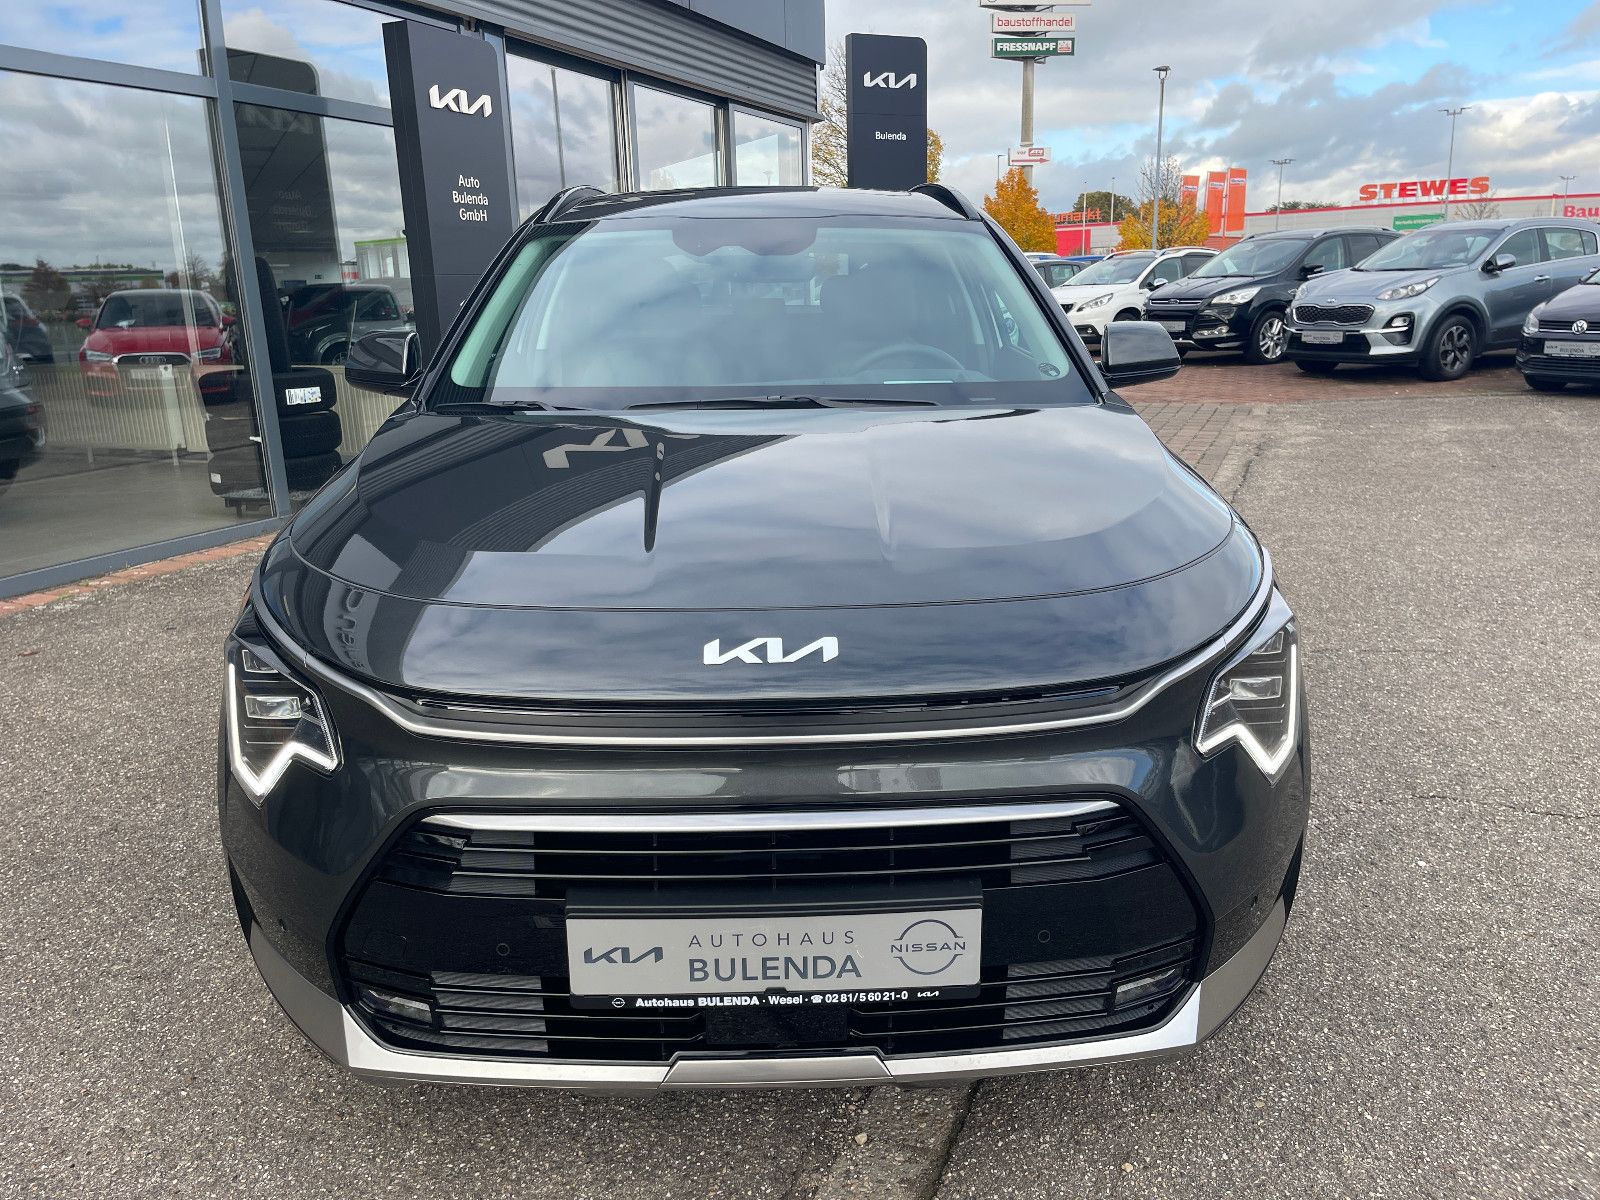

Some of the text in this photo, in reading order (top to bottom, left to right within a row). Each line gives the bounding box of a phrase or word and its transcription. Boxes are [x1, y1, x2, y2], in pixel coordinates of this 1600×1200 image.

[997, 17, 1073, 27] baustoffhandel
[996, 42, 1057, 52] FRESSNAPF
[863, 71, 917, 89] KIA
[429, 84, 493, 118] KIA
[875, 131, 907, 141] Bulenda
[458, 174, 480, 189] Auto
[1359, 176, 1490, 202] STEWES
[452, 190, 489, 206] Bulenda
[459, 208, 488, 222] GmbH
[703, 636, 839, 665] KIA
[688, 930, 855, 949] AUTOHAUS
[890, 940, 966, 954] NISSAN
[583, 946, 664, 964] KIA
[688, 954, 863, 982] BULENDA
[635, 997, 695, 1008] Autohaus
[697, 995, 760, 1007] BULENDA
[767, 994, 803, 1005] Wesel
